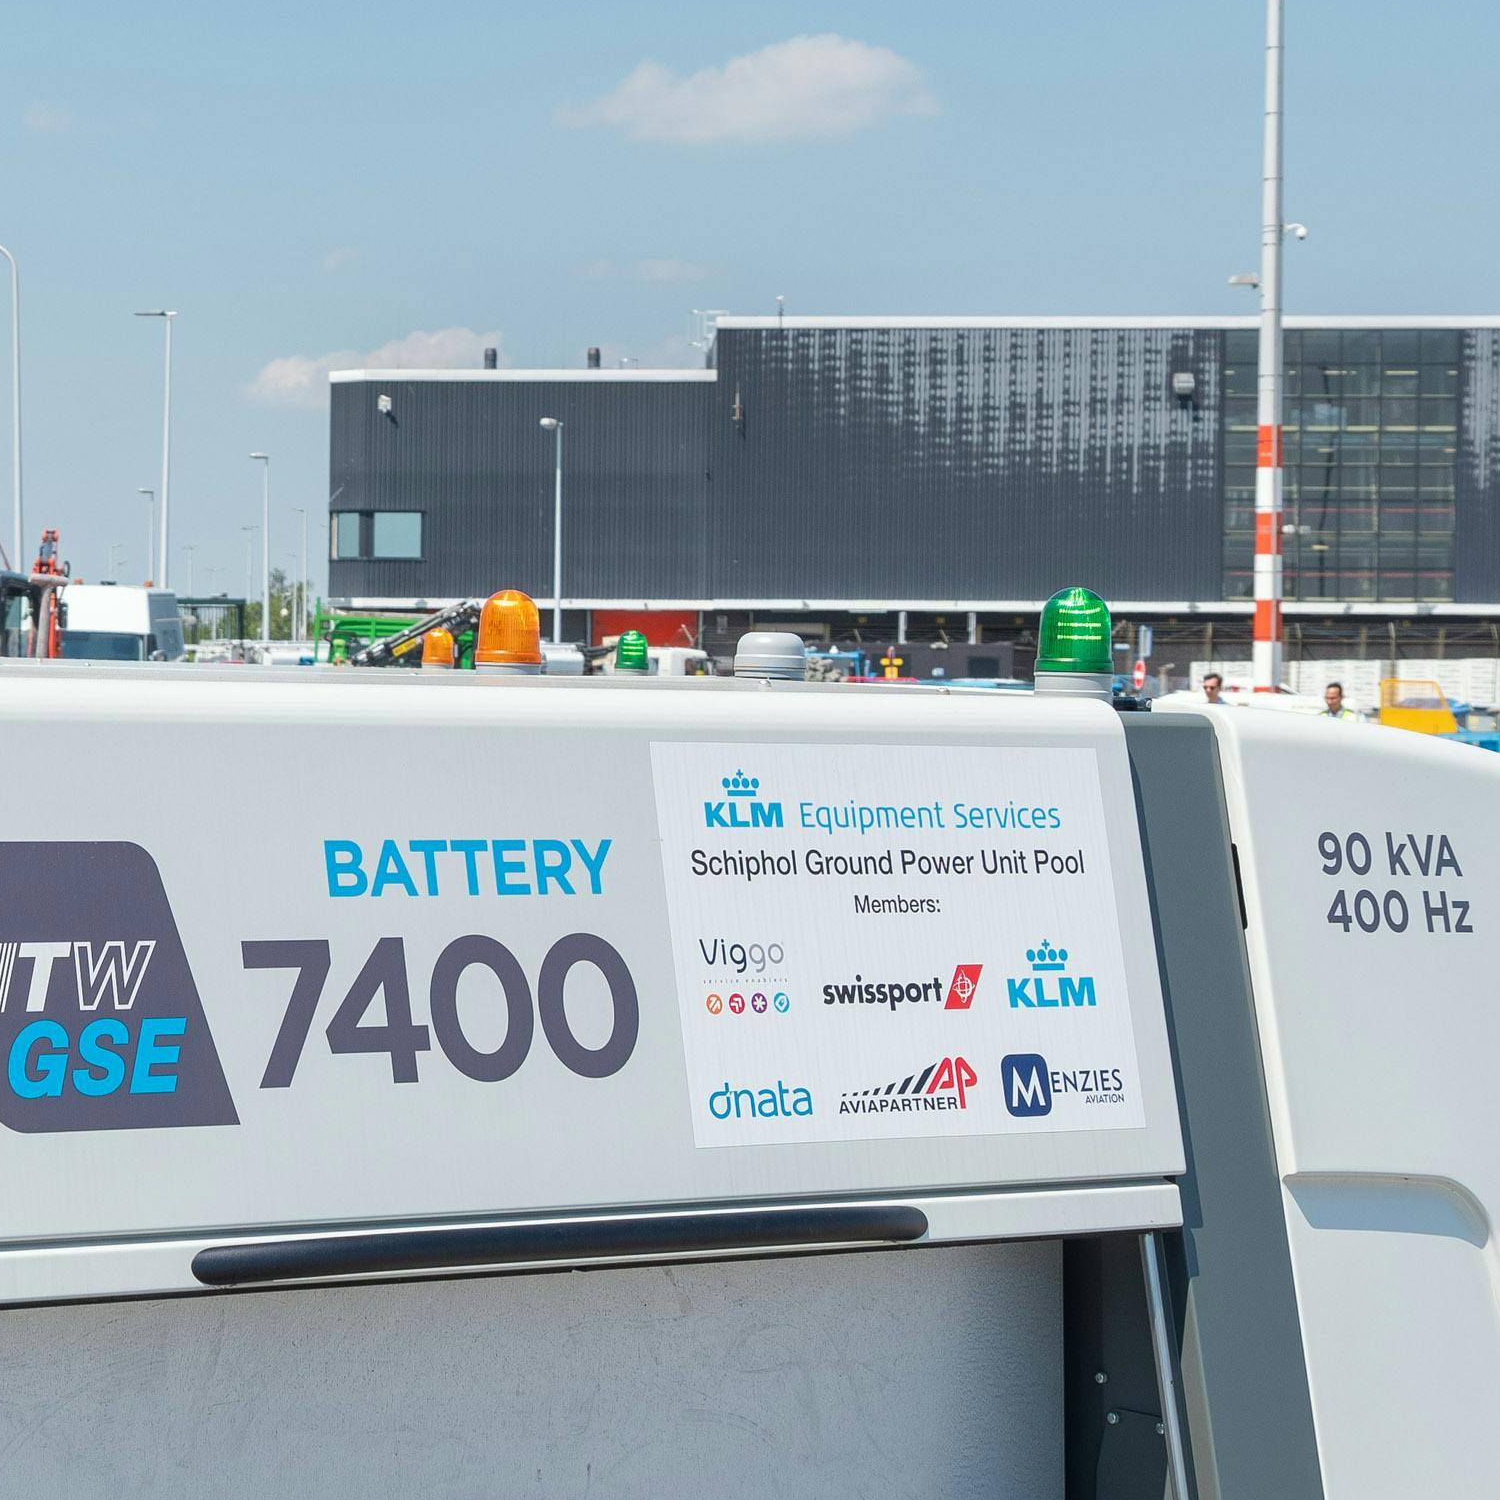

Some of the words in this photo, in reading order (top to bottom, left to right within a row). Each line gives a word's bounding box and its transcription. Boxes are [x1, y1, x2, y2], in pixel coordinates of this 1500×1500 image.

[704, 802, 783, 828] KLM
[800, 801, 945, 835] Equipment
[953, 801, 1061, 829] Services
[323, 838, 612, 897] BATTERY
[690, 849, 798, 881] Schiphol
[805, 849, 894, 876] Ground
[901, 849, 975, 875] Power
[981, 848, 1028, 874] Unit
[1035, 848, 1085, 875] Pool
[1318, 831, 1372, 876] 90
[1385, 831, 1463, 877] kVA
[854, 894, 941, 914] Members:
[1327, 889, 1409, 933] 400
[1423, 890, 1474, 933] Hz
[698, 938, 784, 973] Viggo
[241, 932, 640, 1089] 7400
[823, 974, 942, 1011] swissport
[1006, 977, 1097, 1008] KLM
[7, 1016, 187, 1099] GSE
[709, 1080, 813, 1119] dnata
[839, 1096, 958, 1115] AVIAPARTNER
[1085, 1093, 1125, 1104] AVIATION
